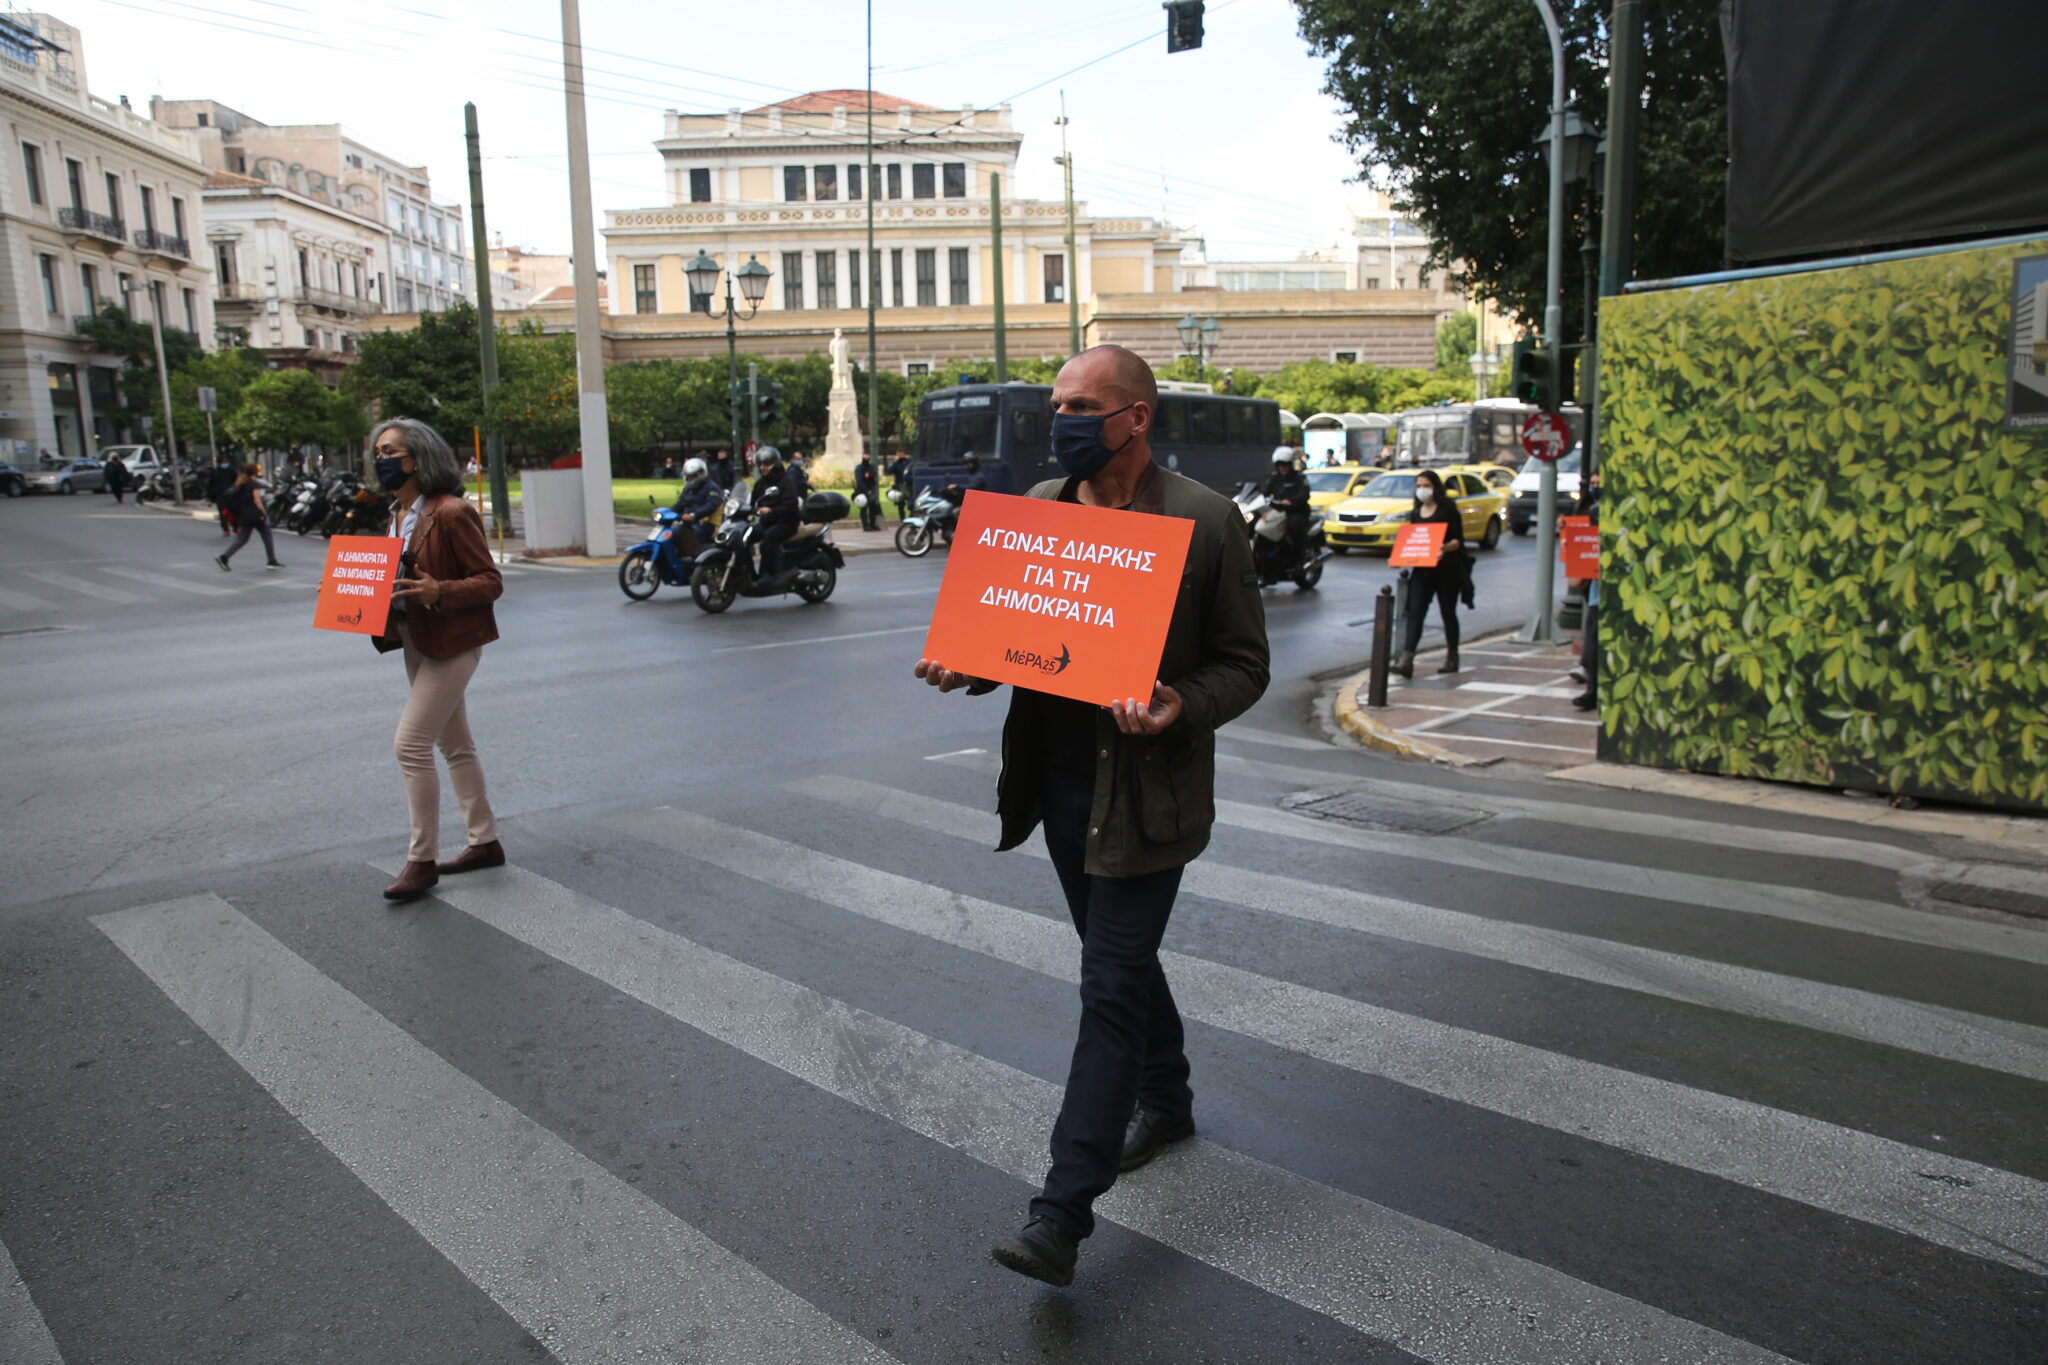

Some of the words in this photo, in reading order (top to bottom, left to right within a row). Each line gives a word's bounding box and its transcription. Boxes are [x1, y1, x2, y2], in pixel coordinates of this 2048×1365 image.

[337, 551, 344, 562] Η
[343, 552, 388, 565] ΔΗΜΟΚΡΑΤΙΑ
[978, 527, 1059, 557] ΑΓΩΝΑΣ
[1060, 540, 1157, 572] ΔΙΑΡΚΗΣ
[332, 567, 347, 578] ΔΕΝ
[347, 568, 376, 580] ΜΠΑΙΝΕΙ
[376, 570, 386, 581] ΣΕ
[1023, 564, 1054, 588] ΓΙΑ
[1062, 570, 1090, 593] ΤΗ
[336, 583, 375, 597] ΚΑΡΑΝΤΙΝΑ
[980, 586, 1115, 628] ΔΗΜΟΚΡΑΤΙΑ
[1005, 648, 1056, 671] ΜέΡΑ25
